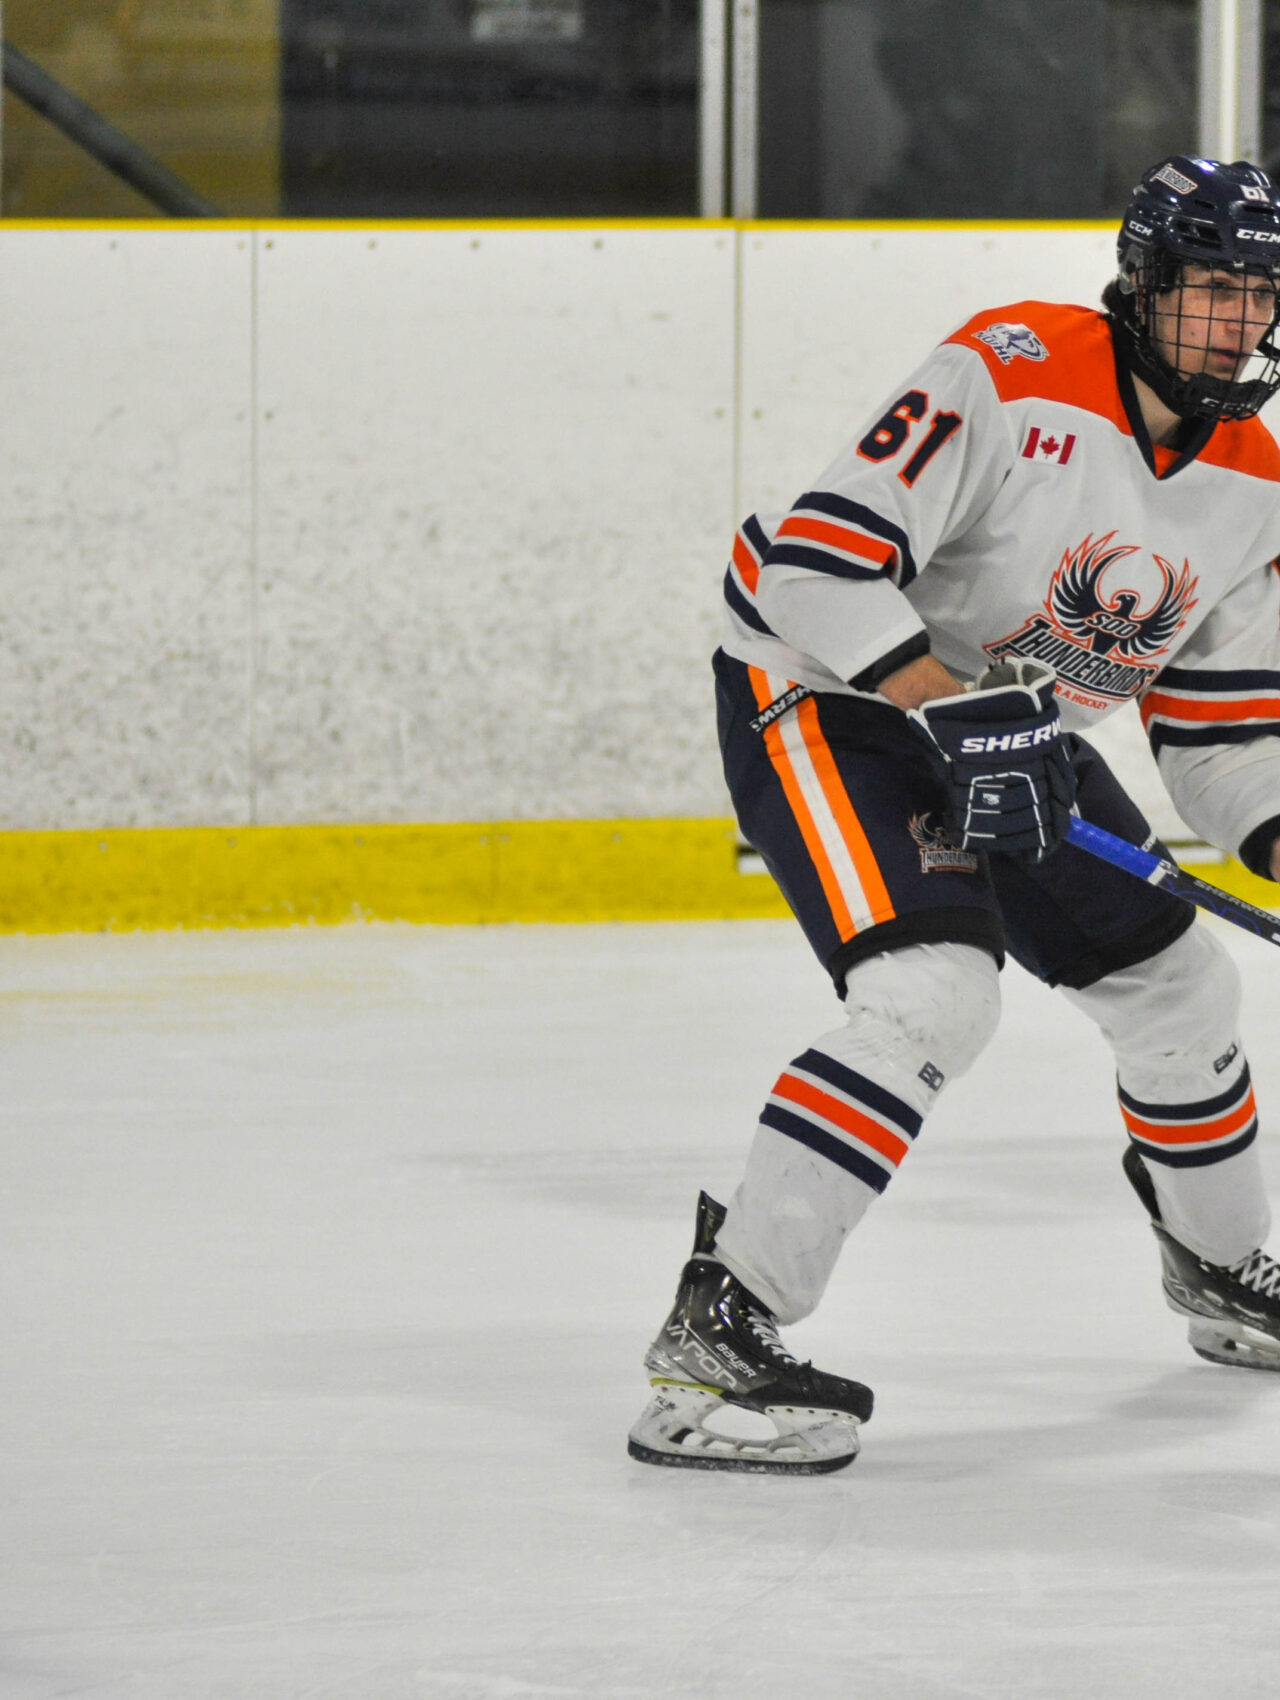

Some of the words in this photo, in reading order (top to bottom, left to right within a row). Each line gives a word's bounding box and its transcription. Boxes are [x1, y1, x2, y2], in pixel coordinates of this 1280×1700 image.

[1129, 220, 1153, 236] CCM
[855, 389, 962, 489] 61
[1087, 612, 1139, 636] SOO
[1008, 616, 1156, 692] THUNDERBIRDS
[666, 1318, 738, 1392] VAPOR
[715, 1343, 757, 1378] BAUER
